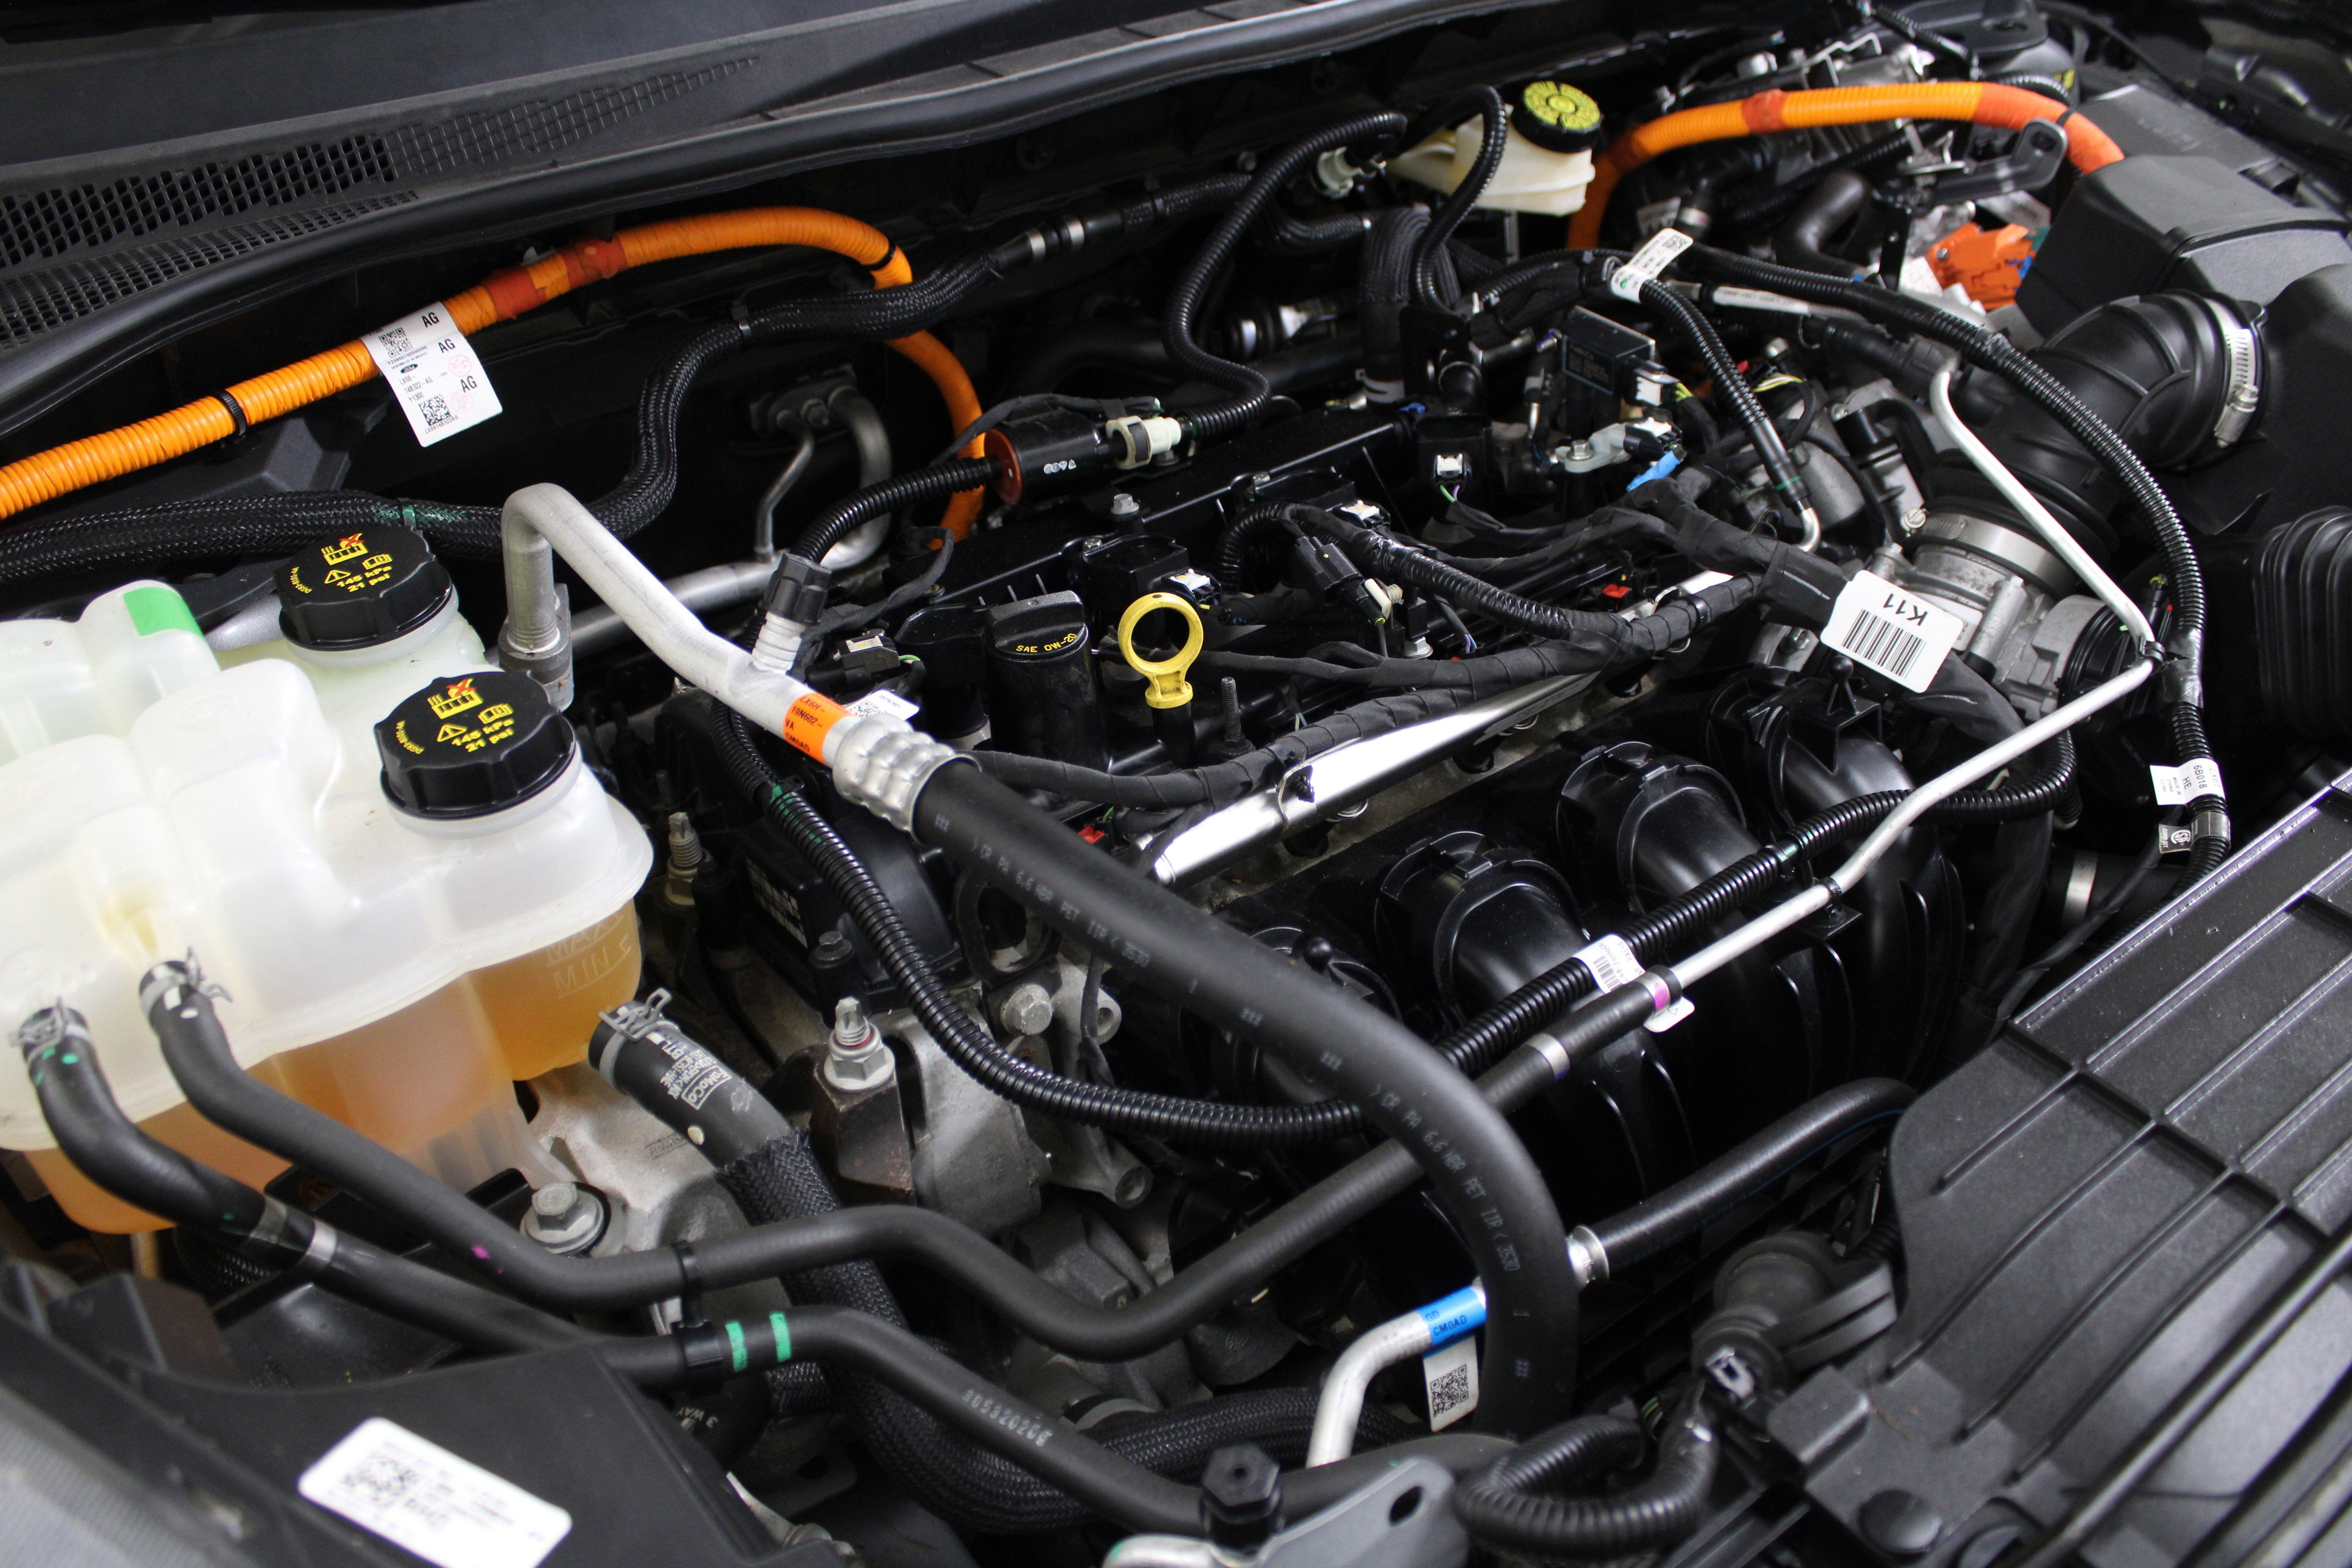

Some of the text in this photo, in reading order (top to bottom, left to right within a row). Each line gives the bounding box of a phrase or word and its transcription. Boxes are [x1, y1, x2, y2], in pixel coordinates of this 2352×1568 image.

[421, 312, 439, 327] AG
[438, 339, 455, 353] AG
[460, 375, 477, 393] AG
[337, 566, 393, 587] 145 kPa
[348, 573, 391, 592] 21 psi
[1883, 593, 1928, 626] K11
[1016, 644, 1038, 653] SAE
[800, 696, 825, 713] LX6H-
[785, 719, 794, 731] VA
[791, 706, 822, 728] 19N602-
[452, 718, 514, 746] 145 kPa
[465, 728, 514, 753] 21 psi
[2183, 776, 2192, 790] HE
[2194, 765, 2207, 789] 6B018
[688, 1067, 730, 1103] FoMoCo
[1402, 1109, 1422, 1129] PA
[1463, 1177, 1487, 1199] PET
